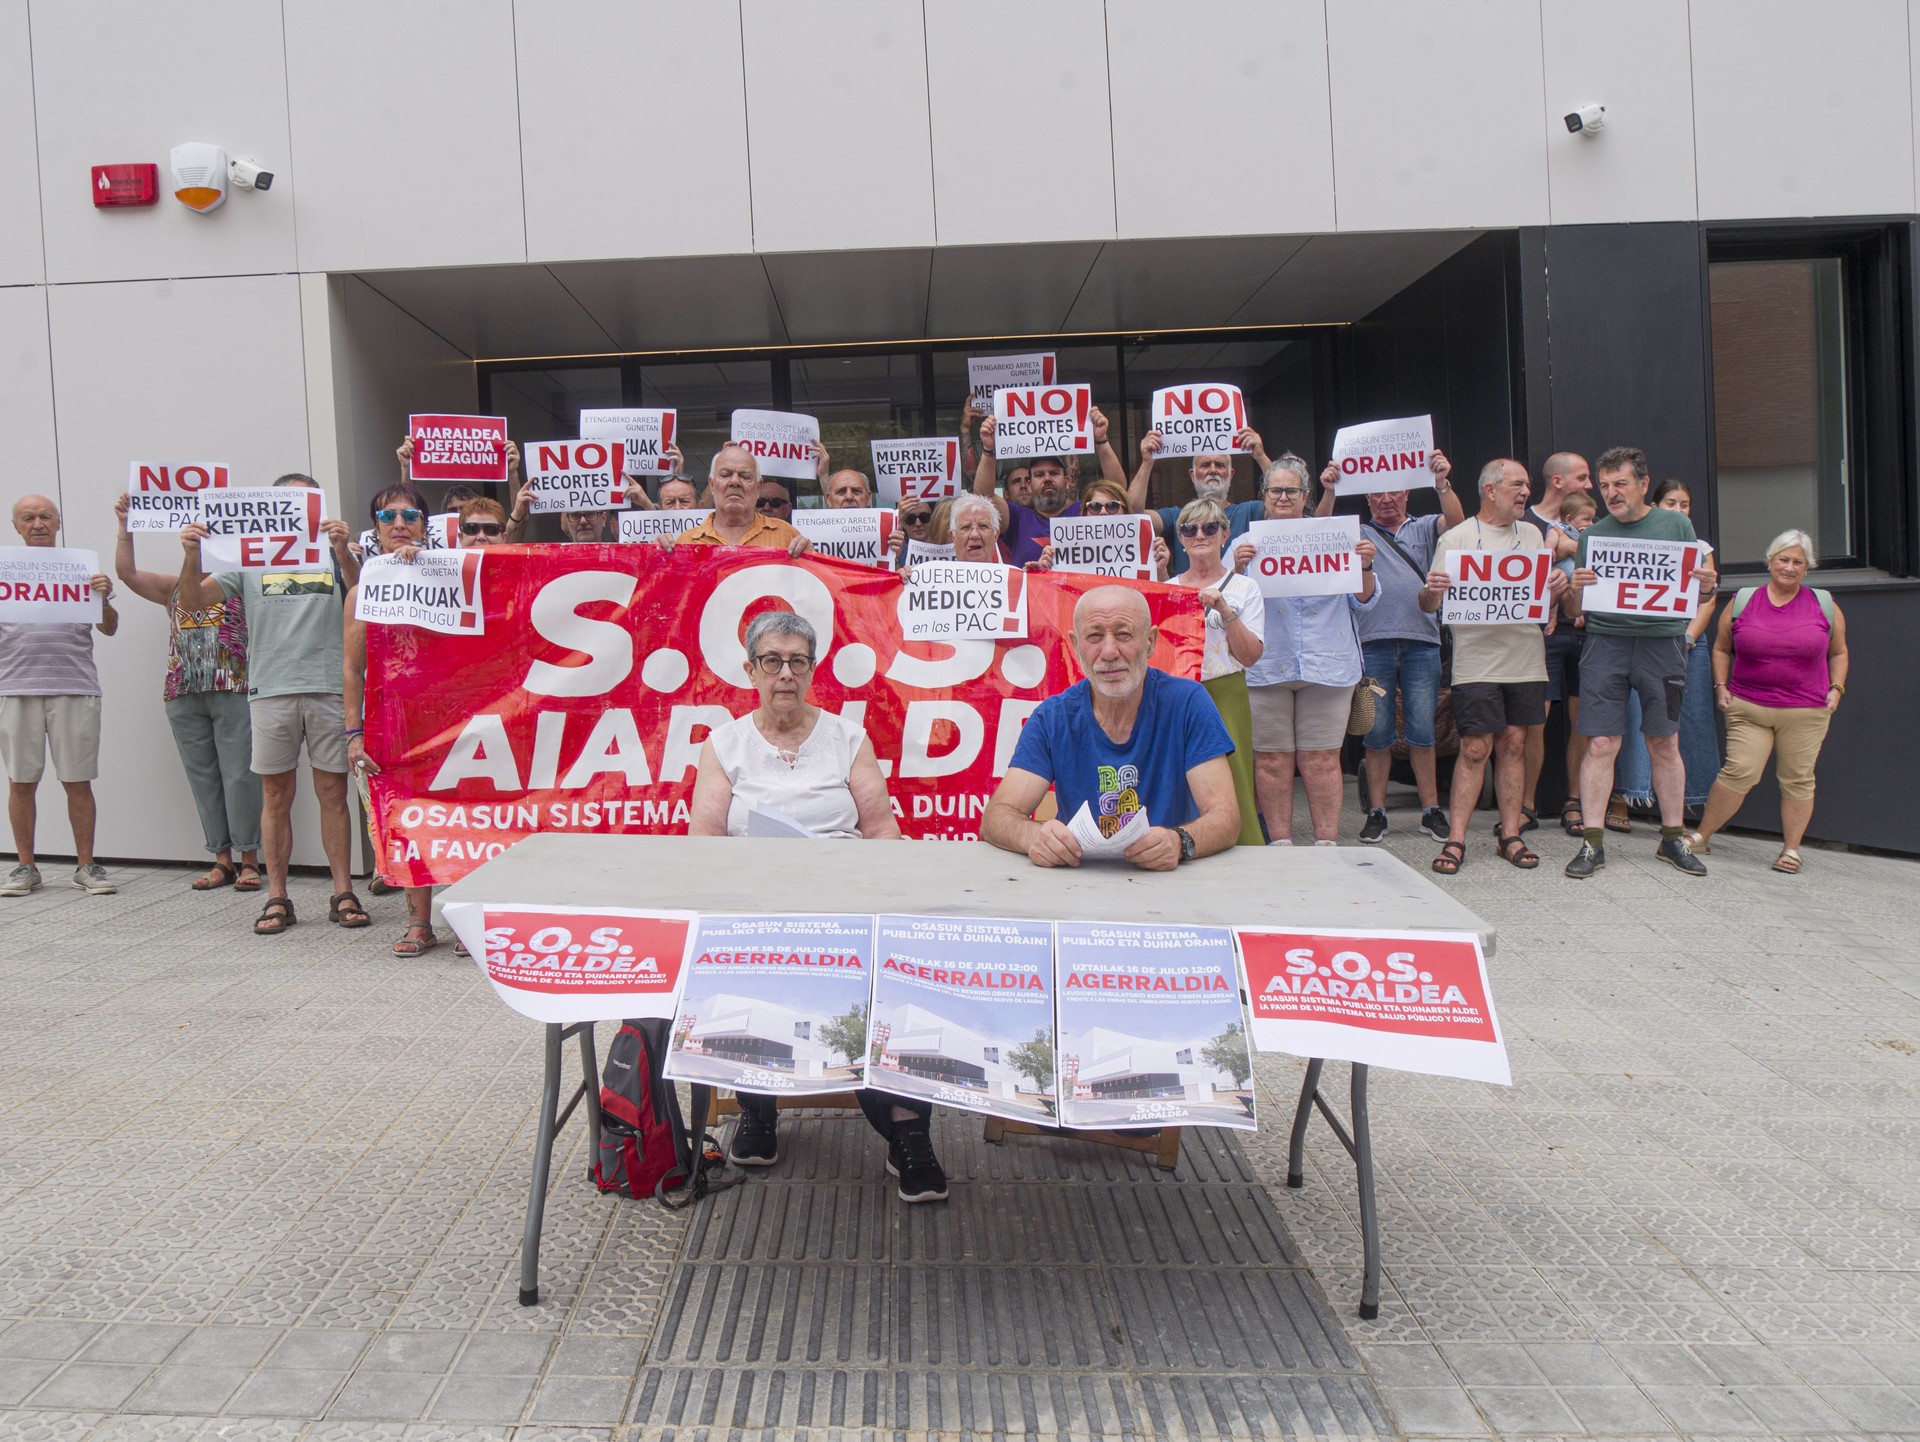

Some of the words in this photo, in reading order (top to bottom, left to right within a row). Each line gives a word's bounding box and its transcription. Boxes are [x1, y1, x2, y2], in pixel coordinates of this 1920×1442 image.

[415, 427, 501, 439] AIARALDEA
[741, 422, 774, 431] OSASUN
[776, 424, 809, 433] SISTEMA
[998, 419, 1073, 436] RECORTES
[1156, 418, 1232, 435] RECORTES
[738, 431, 771, 439] PUBLIKO
[773, 432, 787, 440] ETA
[1172, 443, 1187, 453] los
[1191, 434, 1228, 451] PAC
[1344, 436, 1379, 446] OSASUN
[1381, 432, 1421, 442] SISTEMA
[424, 440, 494, 452] DEFENDA
[1001, 446, 1014, 455] en
[1016, 443, 1031, 454] los
[1035, 436, 1070, 452] PAC
[1340, 446, 1377, 455] PUBLIKO
[1380, 443, 1395, 452] ETA
[1398, 441, 1425, 451] DUINA
[420, 452, 498, 464] DEZAGUN!
[877, 449, 942, 462] MURRIZ-
[1342, 450, 1424, 475] ORAIN!
[878, 462, 943, 475] KETARIK
[532, 473, 609, 490] RECORTES
[132, 496, 199, 511] RECORTE
[534, 501, 547, 510] en
[550, 500, 565, 509] los
[569, 490, 606, 507] PAC
[205, 501, 300, 518] MURRIZ-
[132, 519, 146, 527] en
[149, 514, 164, 528] los
[207, 517, 303, 535] KETARIK
[842, 525, 877, 534] GUNETAN
[1053, 522, 1135, 542] QUEREMOS
[1262, 534, 1302, 544] OSASUN
[1305, 532, 1347, 542] SISTEMA
[1055, 543, 1135, 565] MÉDICXS
[1258, 545, 1299, 555] PUBLIKO
[1302, 544, 1319, 553] ETA
[1321, 542, 1352, 552] DUINA
[428, 558, 458, 566] ARRETA
[1260, 553, 1349, 576] ORAIN!
[1592, 550, 1676, 566] MURRIZ-
[41, 562, 87, 572] SISTEMA
[421, 568, 458, 576] GUNETAN
[1592, 565, 1676, 581] KETARIK
[909, 568, 1002, 586] QUEREMOS
[364, 584, 461, 608] MEDIKUAK
[909, 587, 1002, 611] MÉDICXS
[1448, 586, 1530, 601] RECORTES
[363, 605, 404, 618] BEHAR
[409, 607, 454, 626] DITUGU
[1448, 612, 1462, 620] en
[1464, 610, 1481, 620] los
[1486, 604, 1524, 620] PAC
[912, 623, 927, 633] en
[931, 620, 950, 632] los
[955, 613, 997, 632] PAC
[401, 805, 538, 830] OSASUN
[551, 800, 690, 827] SISTEMA
[786, 921, 839, 929] SISTEMA
[912, 922, 962, 933] OSASUN
[966, 925, 1019, 935] SISTEMA
[883, 929, 934, 940] PUBLIKO
[938, 933, 960, 941] ETA
[964, 934, 1001, 943] DUINA
[1005, 936, 1048, 946] ORAIN!
[1063, 938, 1114, 946] PUBLIKO
[1118, 939, 1139, 947] ETA
[1143, 940, 1182, 948] DUINA
[1185, 939, 1227, 947] ORAIN!
[1091, 930, 1141, 938] OSASUN
[1145, 932, 1198, 940] SISTEMA
[696, 953, 862, 968] AGERRALDIA
[890, 953, 941, 967] UZTAILAK
[976, 963, 1006, 971] JULIO
[1009, 964, 1038, 972] 12:00
[1285, 948, 1433, 983] S.O.S.
[883, 958, 1044, 990] AGERRALDIA
[1072, 964, 1124, 972] UZTAILAK
[1192, 966, 1221, 974] 12:00
[498, 973, 537, 982] SISTEMA
[1065, 973, 1229, 991] AGERRALDIA
[1265, 976, 1468, 1005] AIARALDEA
[1301, 996, 1341, 1006] SISTEMA
[1344, 1000, 1381, 1012] PUBLIKO
[1384, 1004, 1401, 1012] ETA
[1403, 1005, 1450, 1013] DUINAREN
[1452, 1007, 1479, 1015] ALDE!
[1327, 1007, 1364, 1017] SISTEMA
[1379, 1012, 1406, 1020] SALUD
[1408, 1014, 1443, 1022] PÚBLICO
[1453, 1016, 1483, 1024] DIGNO!
[734, 1078, 794, 1088] AIARALDEA
[1129, 1110, 1189, 1121] AIARALDEA
